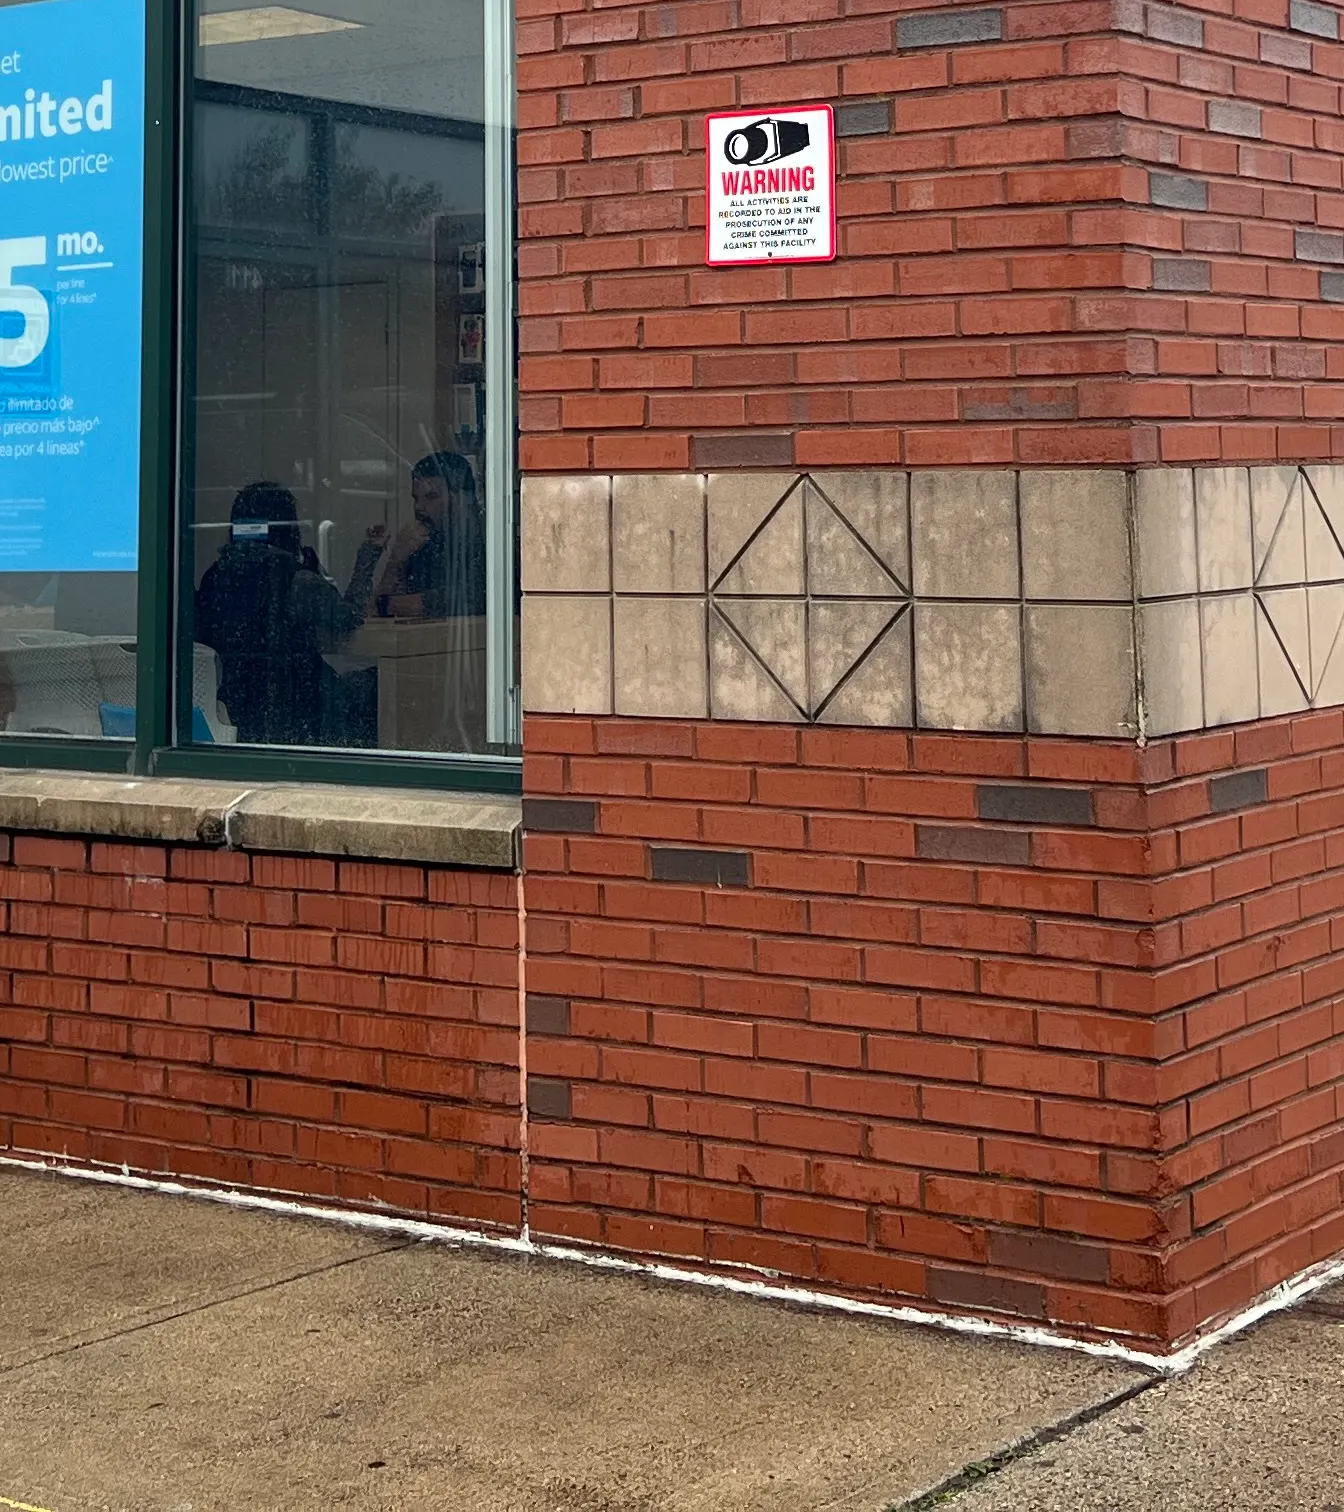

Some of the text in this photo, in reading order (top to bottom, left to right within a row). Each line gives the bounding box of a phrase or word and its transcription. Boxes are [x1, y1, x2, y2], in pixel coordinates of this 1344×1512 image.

[721, 166, 815, 196] WARNING
[746, 196, 790, 206] ACTIVITIES
[792, 195, 809, 203] ARE
[718, 209, 763, 219] RECORDED
[764, 208, 776, 216] TO
[777, 207, 792, 215] AID
[804, 205, 821, 213] THE
[725, 216, 814, 229] PROSECUTION OF ANY
[730, 227, 808, 239] CRIME COMMITTED
[57, 231, 104, 257] mo.
[723, 238, 816, 250] AGAINST THIS FACILITY
[58, 394, 74, 411] de
[14, 443, 35, 460] por
[37, 440, 45, 456] 4
